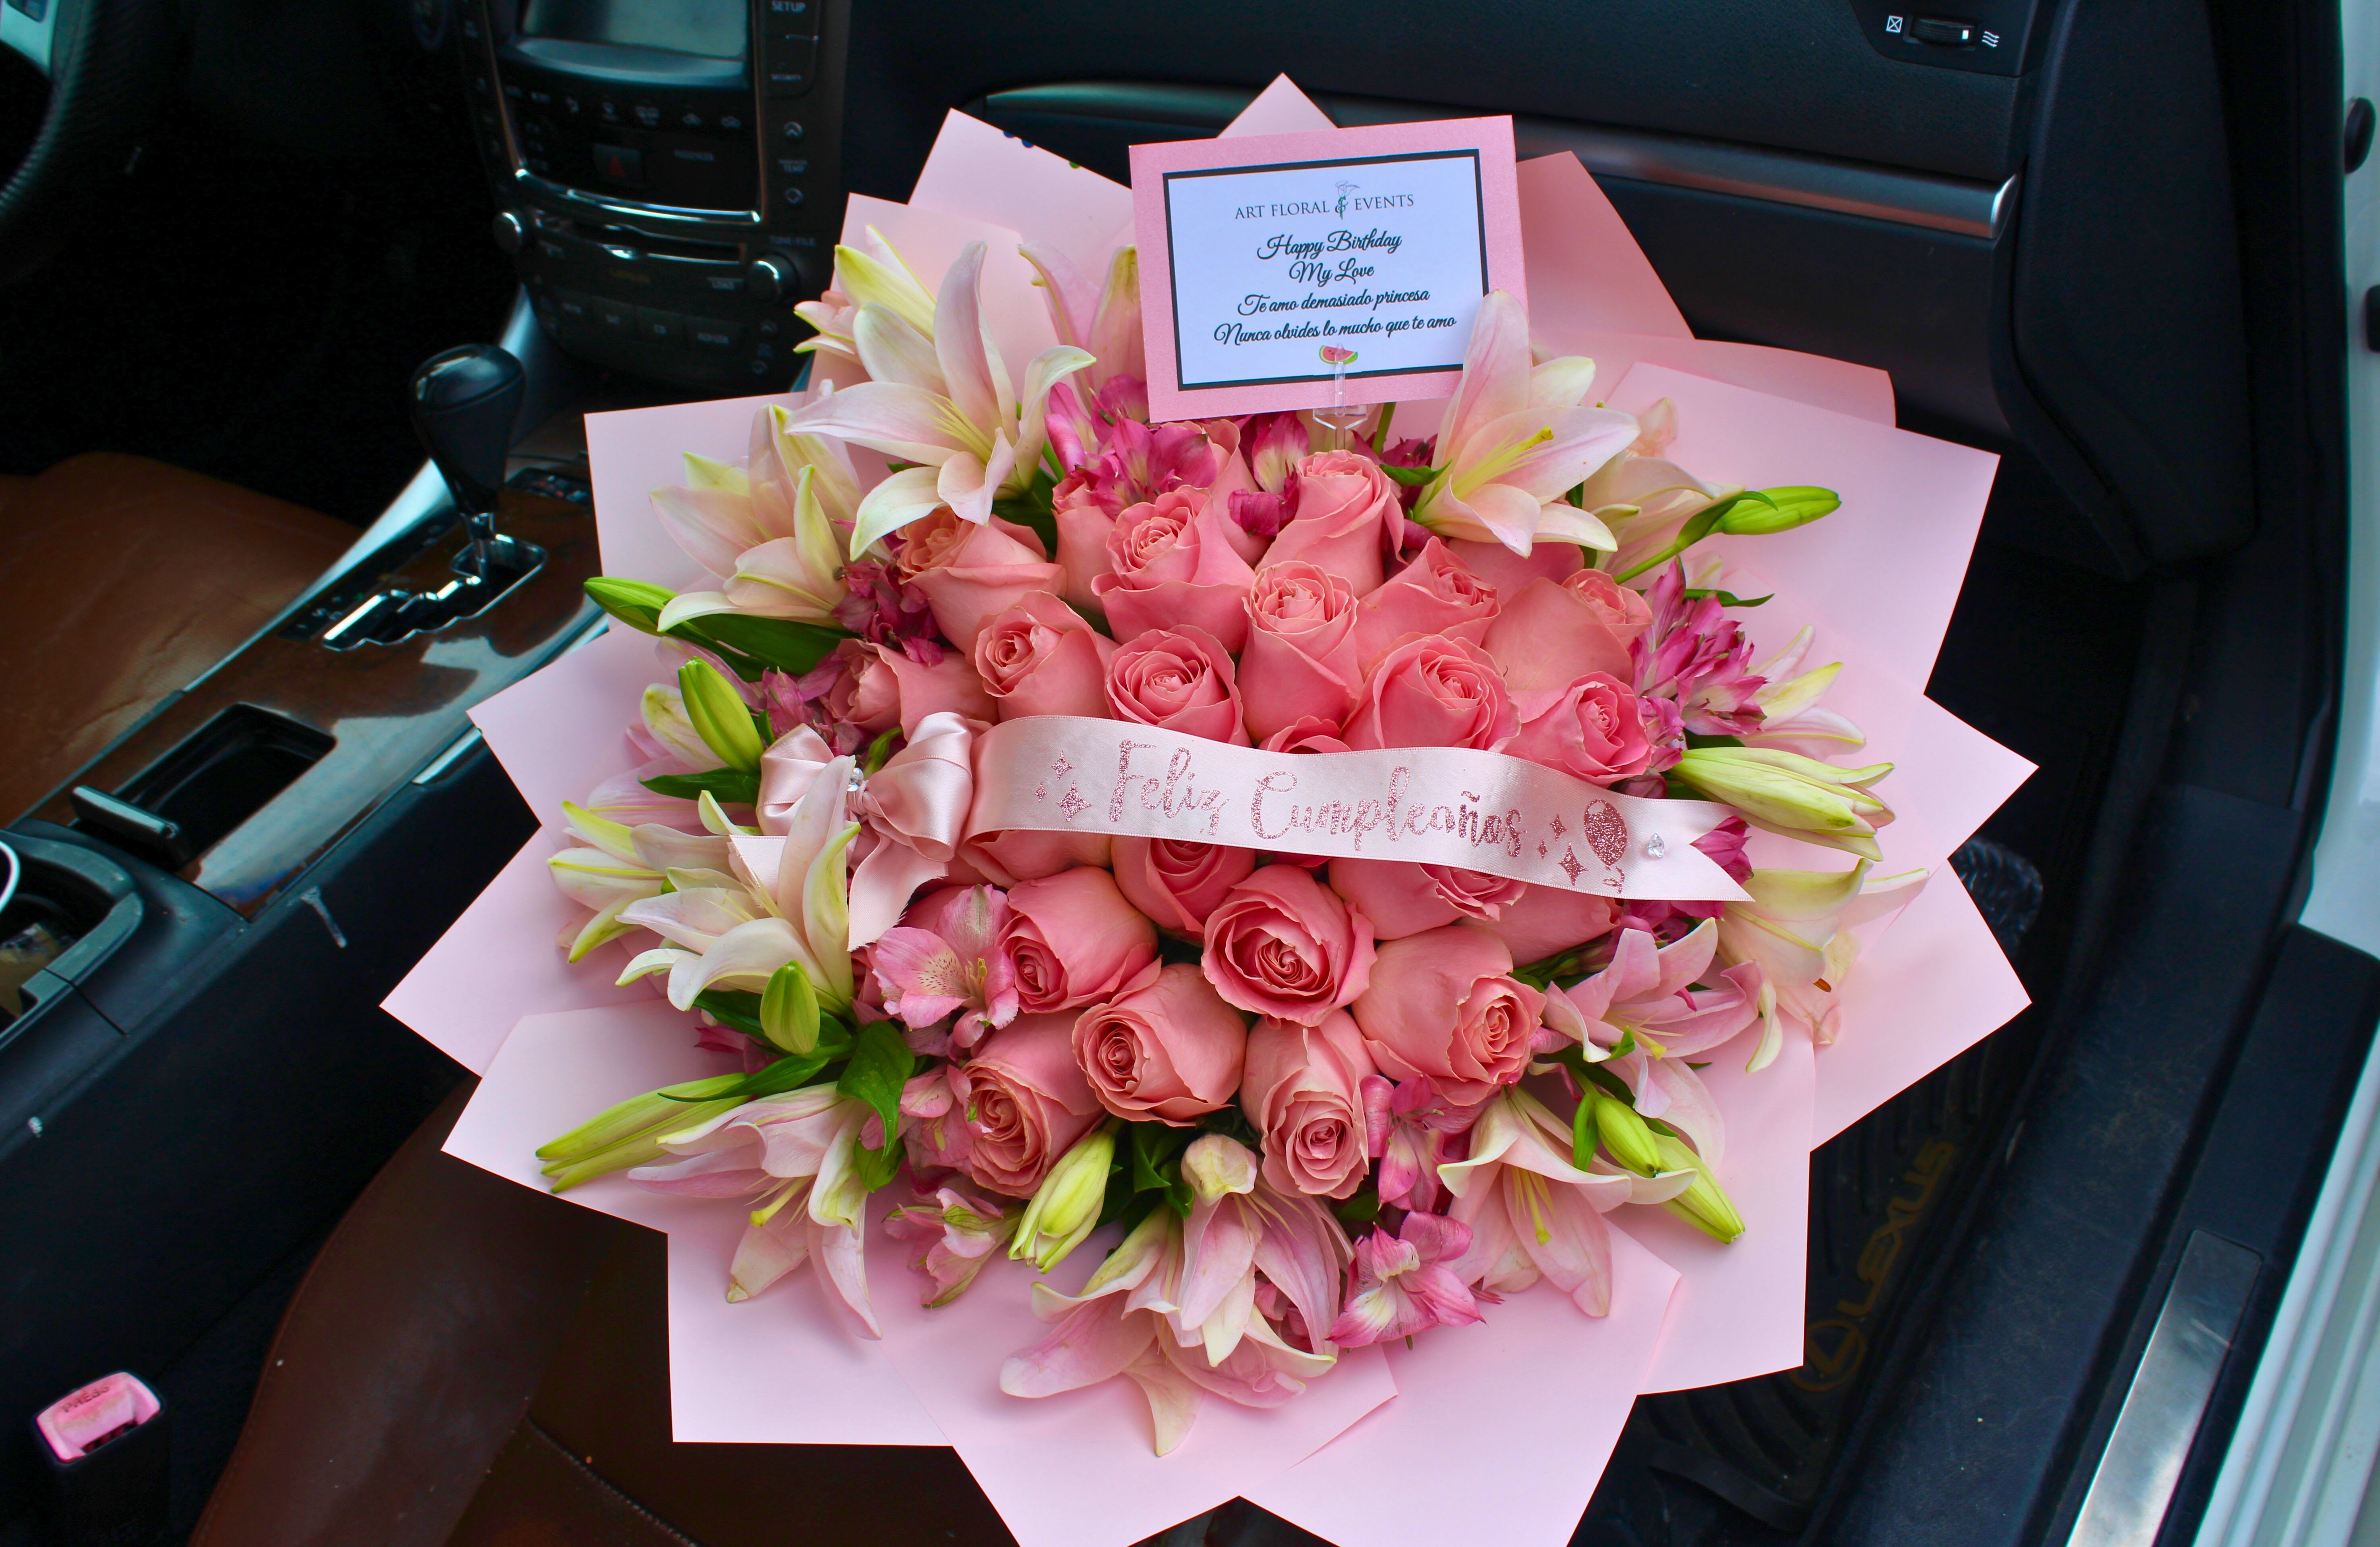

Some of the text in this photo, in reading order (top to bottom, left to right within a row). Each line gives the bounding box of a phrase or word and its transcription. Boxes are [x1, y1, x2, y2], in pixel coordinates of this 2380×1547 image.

[771, 1, 807, 13] SETUP
[1234, 194, 1414, 220] ART FLORAL & EVENTS
[1257, 228, 1403, 260] Happy Birthday
[1289, 257, 1375, 287] My Love
[1237, 289, 1430, 316] Te amo demasiado princesa
[1213, 315, 1458, 345] Nunca olvides lo mucho que te amo
[1109, 739, 1528, 858] Feliz Cumpleaños
[1837, 1140, 1955, 1317] LEXUS
